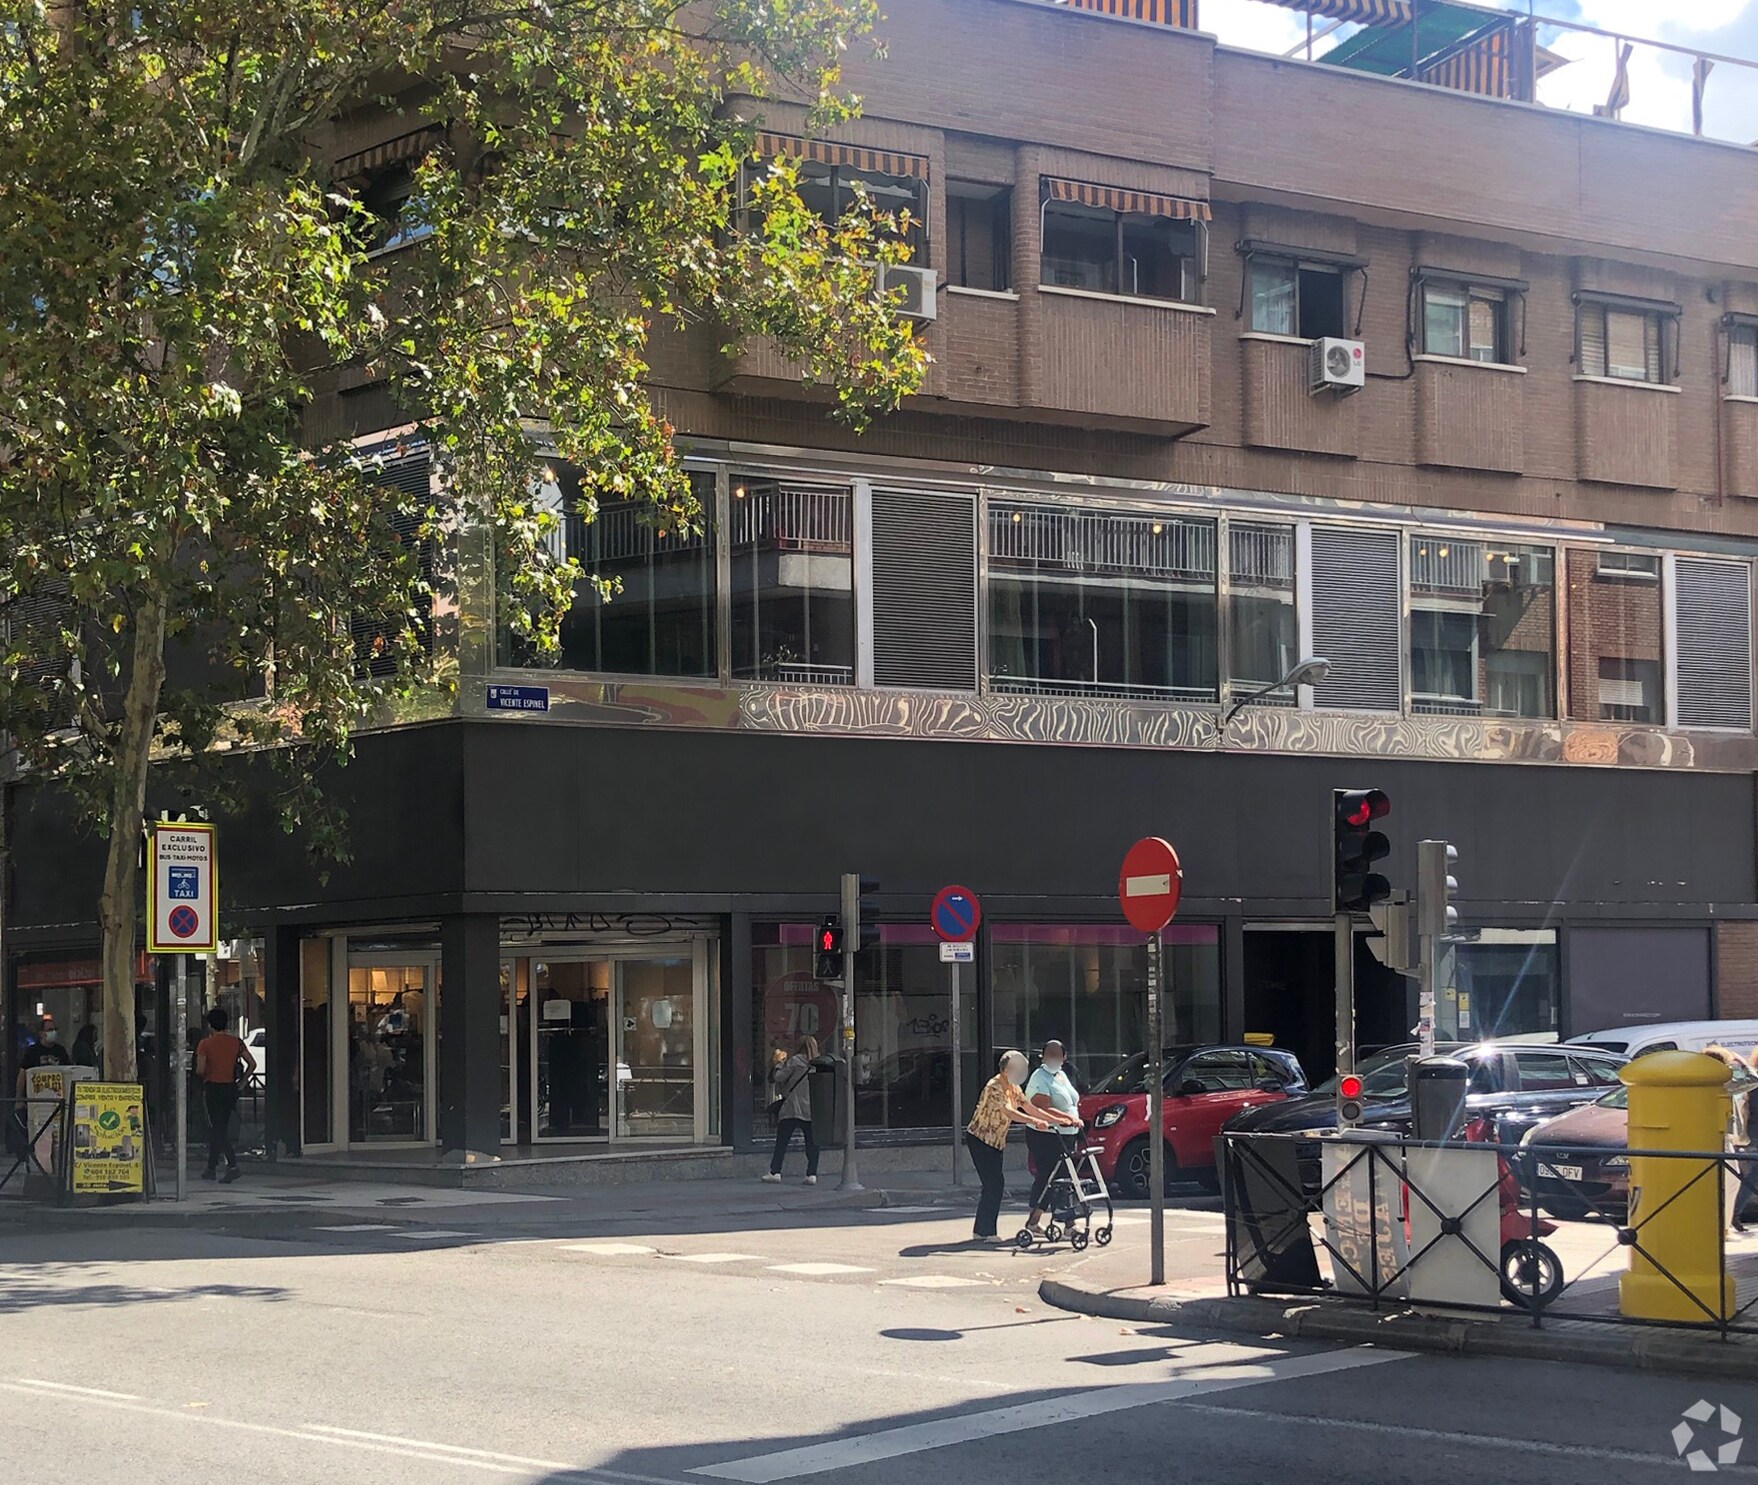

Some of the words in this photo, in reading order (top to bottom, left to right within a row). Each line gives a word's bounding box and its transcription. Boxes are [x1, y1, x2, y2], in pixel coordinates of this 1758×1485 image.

[500, 698, 522, 708] VICENTE
[523, 699, 546, 709] ESPINEL
[161, 844, 206, 853] EXCLUSIVO
[174, 889, 194, 898] TAXI
[783, 980, 820, 992] OFERTAS
[784, 1003, 819, 1036] 70
